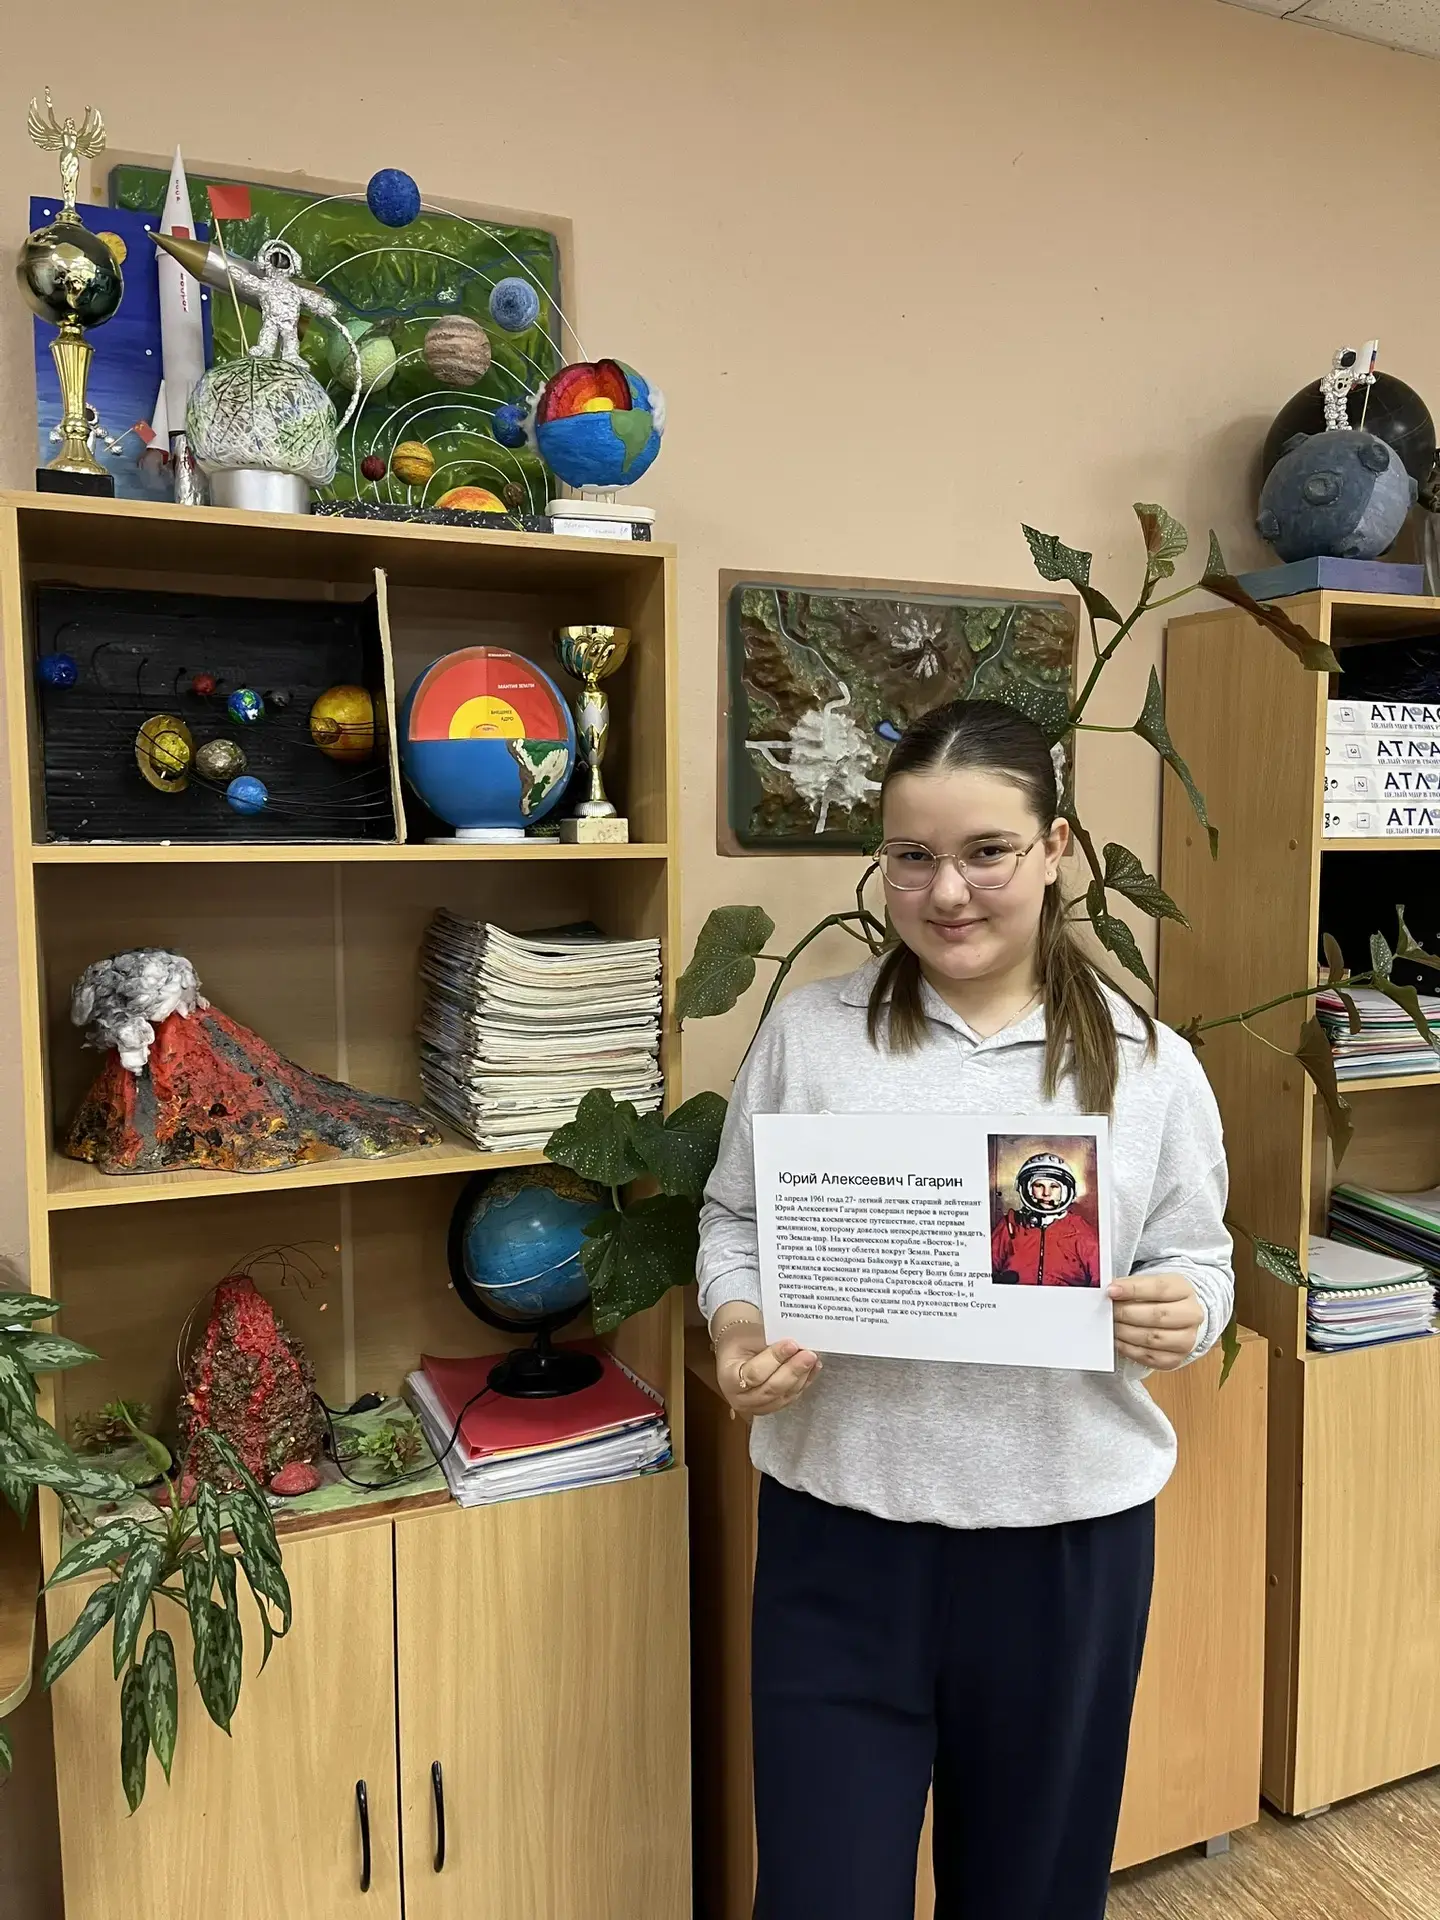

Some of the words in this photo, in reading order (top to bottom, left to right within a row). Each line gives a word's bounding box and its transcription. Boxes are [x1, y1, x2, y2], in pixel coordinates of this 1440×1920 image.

[779, 1172, 817, 1186] Юрий
[822, 1173, 903, 1186] Алексеевич
[908, 1174, 962, 1190] Гагарин
